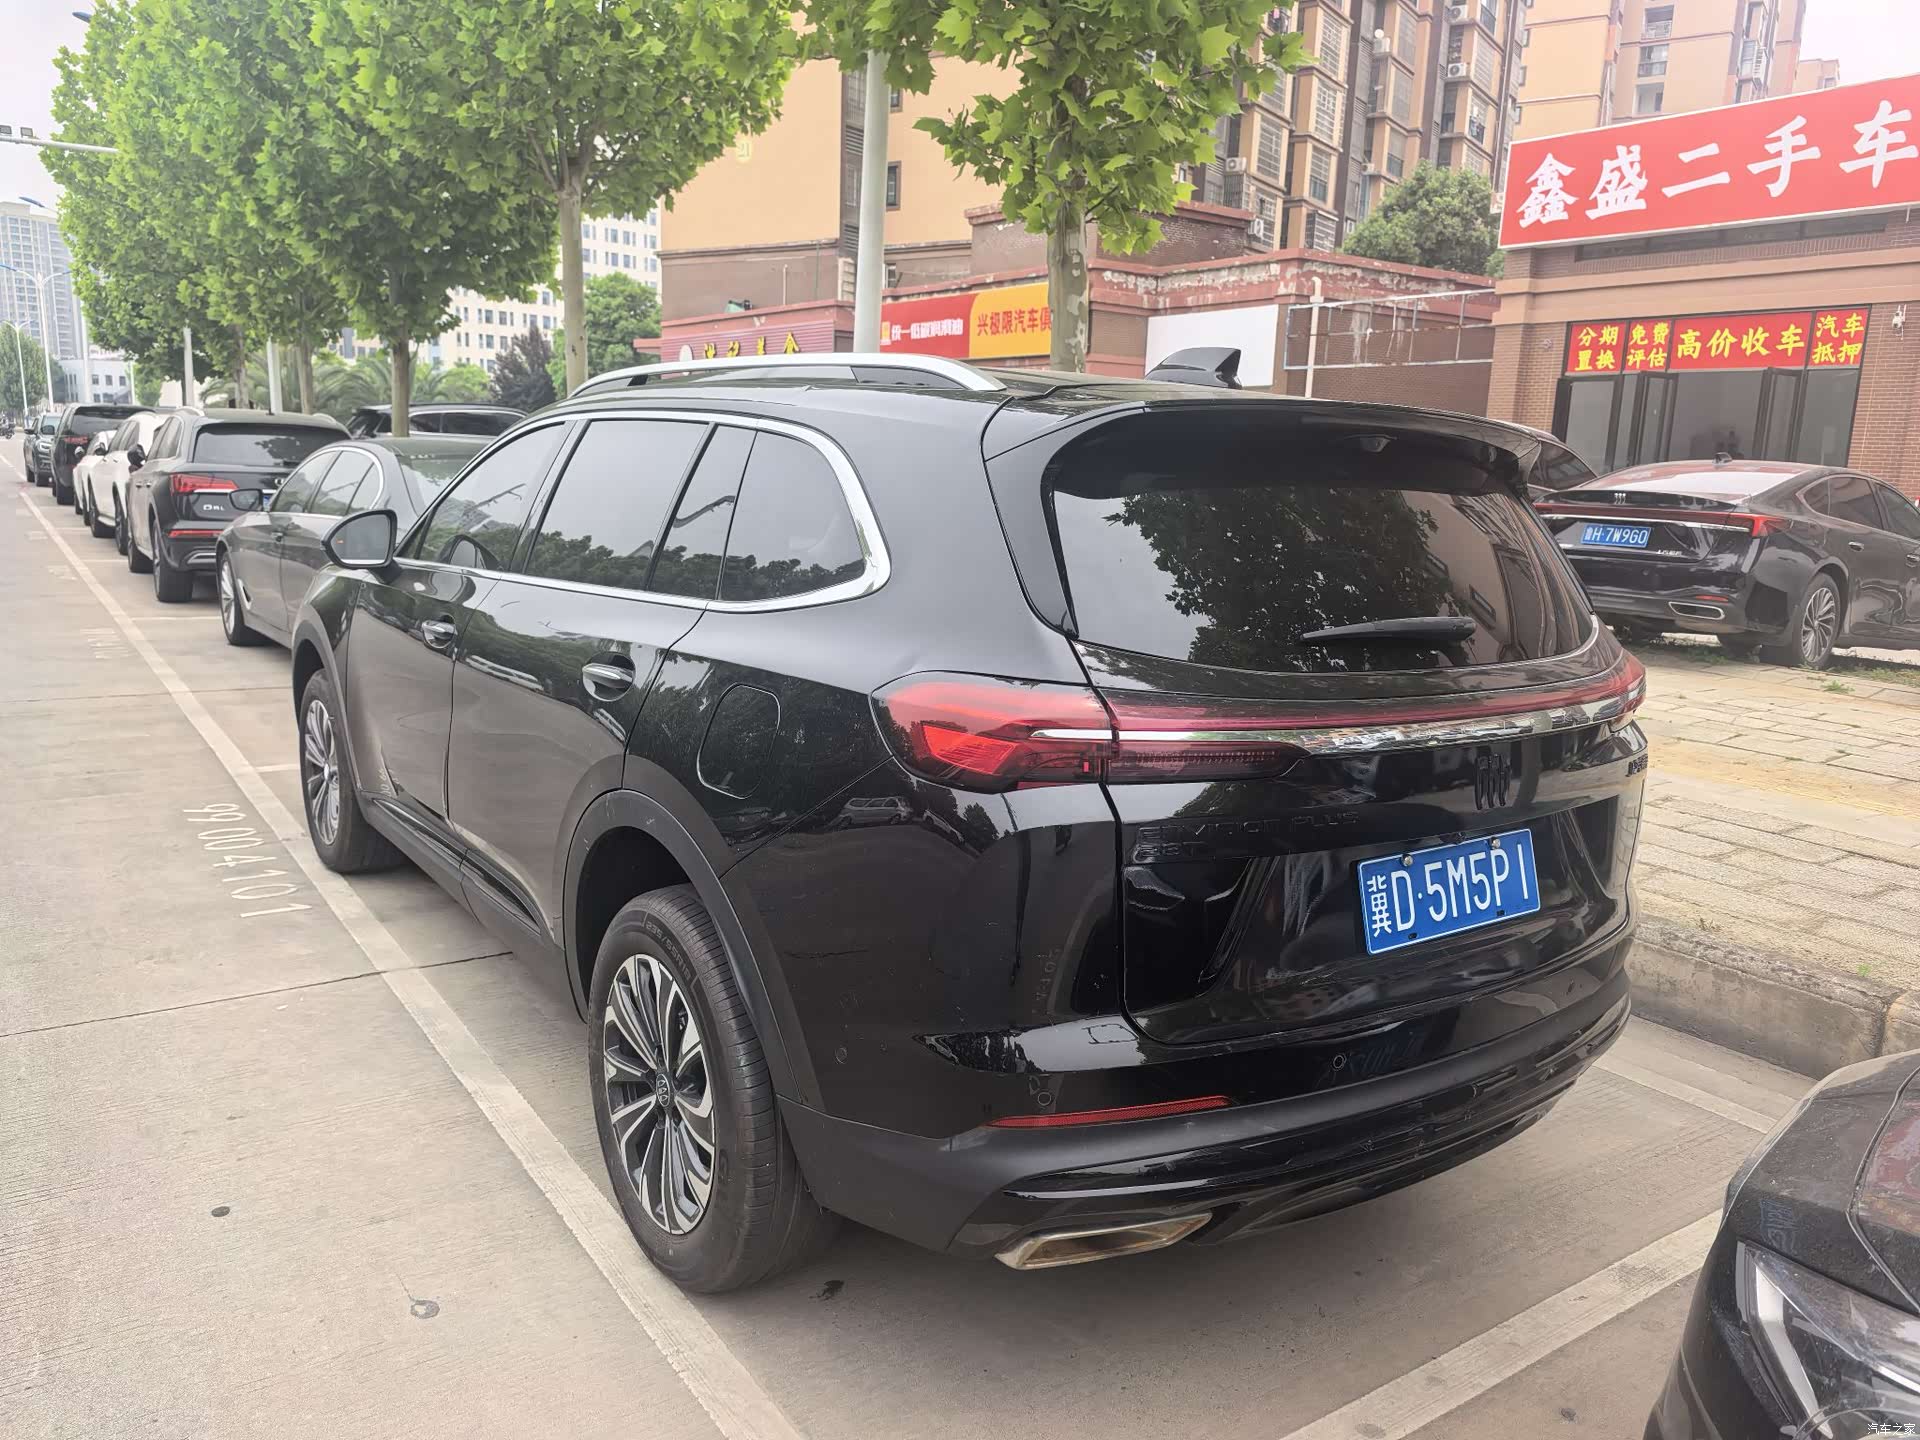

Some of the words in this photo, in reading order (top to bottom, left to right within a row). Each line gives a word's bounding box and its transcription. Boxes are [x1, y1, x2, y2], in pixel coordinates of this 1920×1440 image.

[1516, 99, 1919, 228] 鑫盛二手车
[1578, 326, 1618, 347] 分期
[1629, 322, 1670, 346] 免费
[1817, 313, 1865, 336] 汽车
[1676, 323, 1805, 360] 高价收车
[1813, 340, 1862, 366] 抵押
[1576, 348, 1616, 371] 置换
[1627, 343, 1668, 369] 评估
